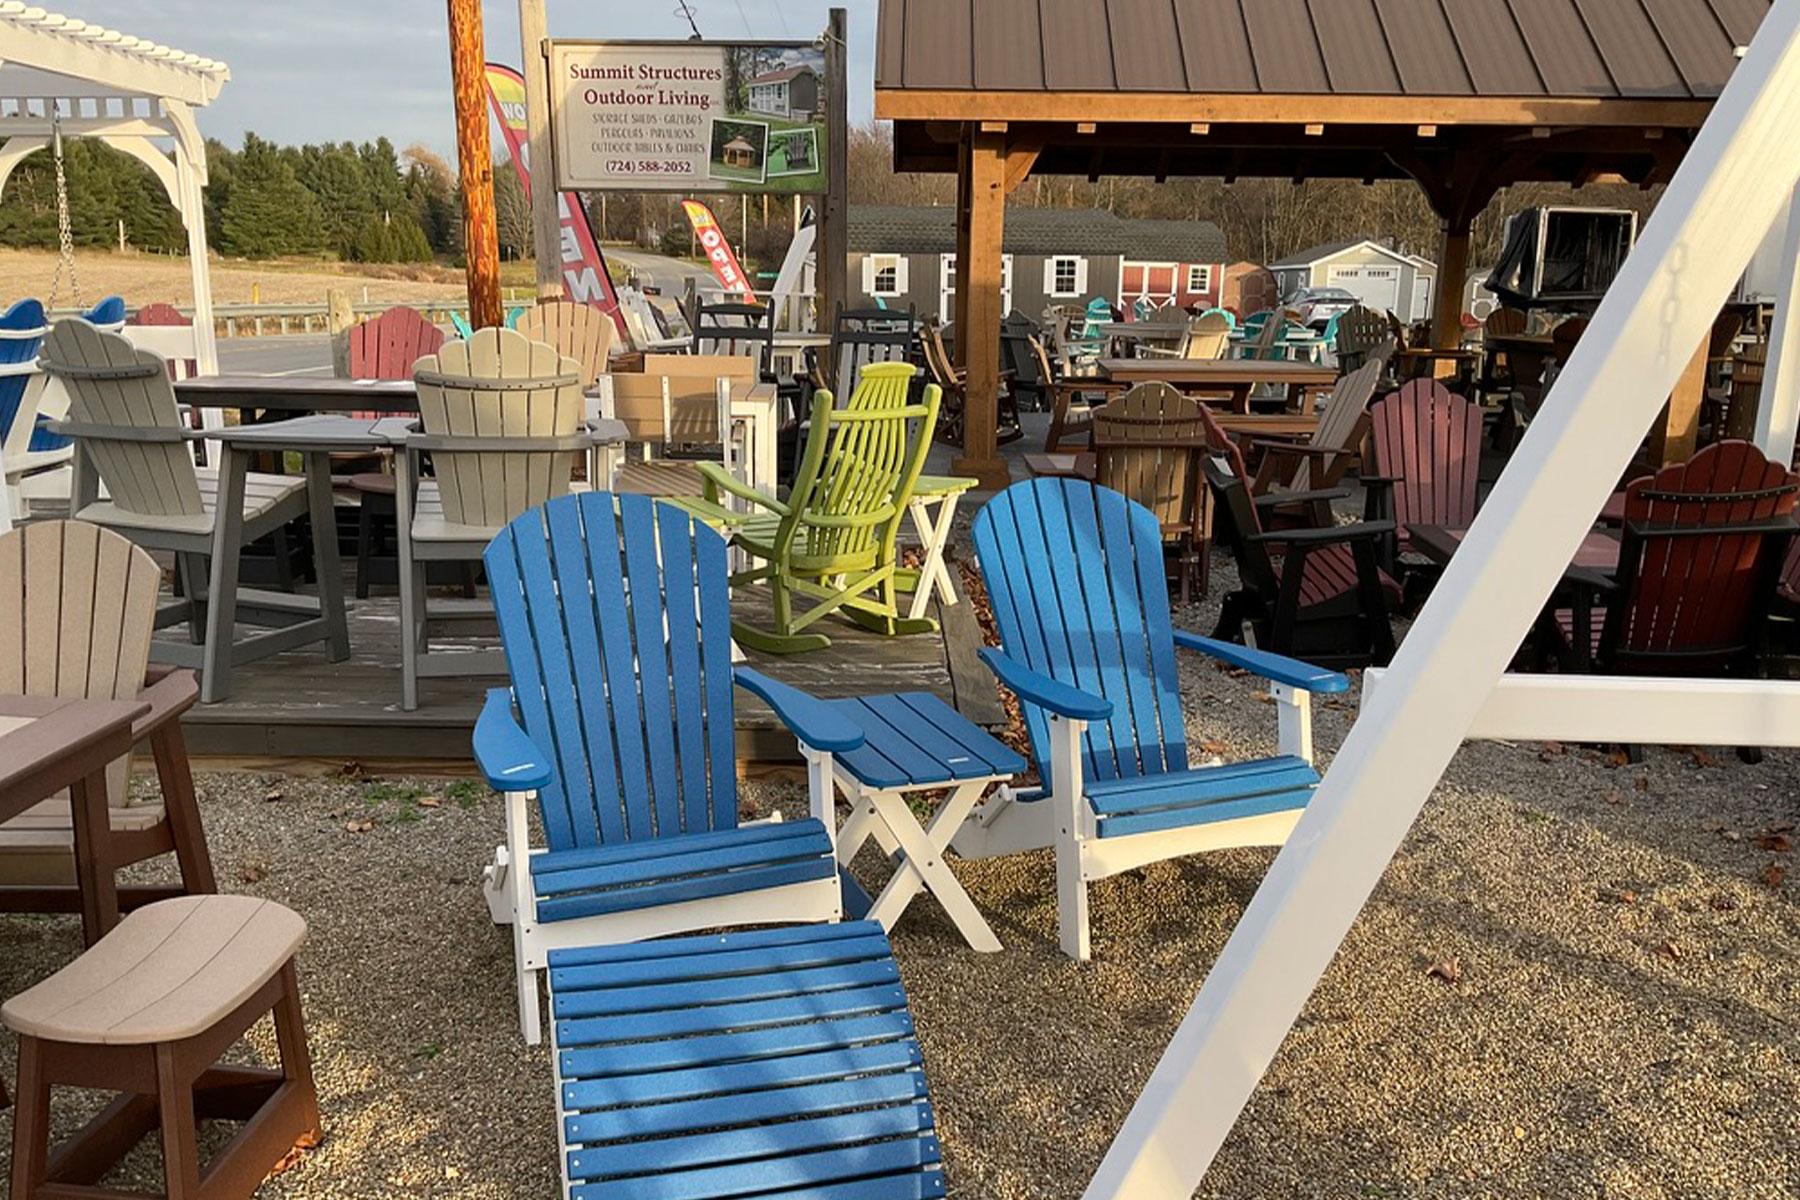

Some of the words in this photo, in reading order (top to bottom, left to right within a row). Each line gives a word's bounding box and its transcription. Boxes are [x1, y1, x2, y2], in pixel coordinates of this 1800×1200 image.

[570, 64, 634, 80] Summit
[639, 63, 722, 81] Structures
[635, 81, 659, 90] and
[584, 88, 654, 105] Outdoor
[658, 90, 711, 110] Living
[631, 113, 658, 124] SHEDS
[664, 113, 703, 126] GAZEBOS
[650, 128, 696, 139] PAVILIONS
[591, 142, 632, 153] OUTDOOR
[605, 160, 636, 173] (724)
[638, 160, 692, 173] 588-2052
